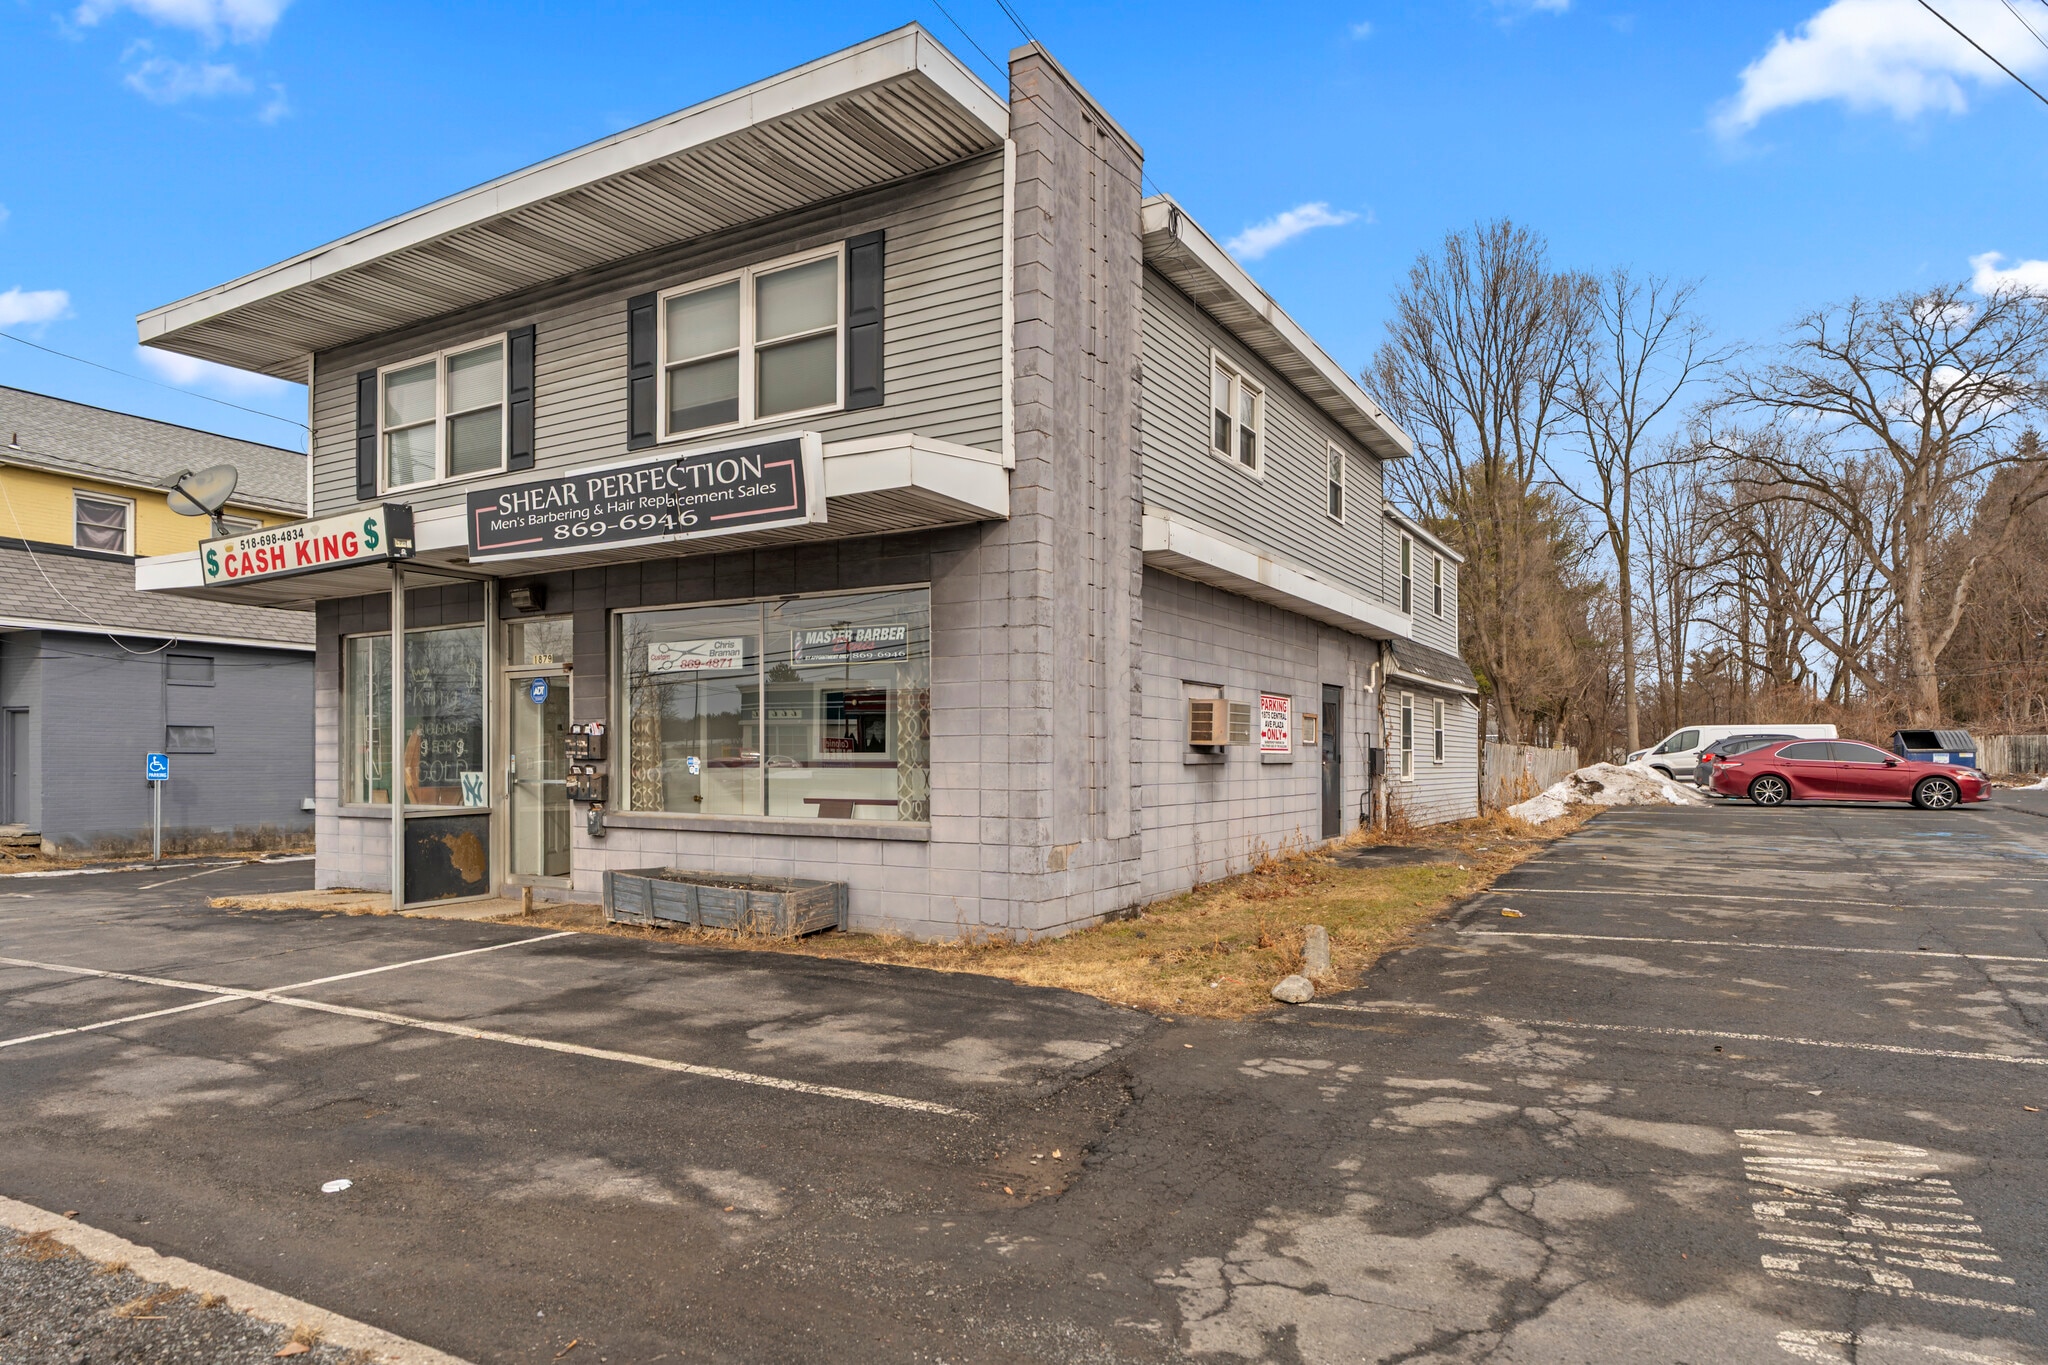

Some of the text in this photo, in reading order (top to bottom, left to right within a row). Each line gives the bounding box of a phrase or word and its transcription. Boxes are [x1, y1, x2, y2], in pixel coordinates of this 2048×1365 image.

[498, 454, 763, 515] SHEAR PERFECTION
[490, 481, 778, 532] Men's Barbering & Hair Replacement Sales
[553, 508, 699, 540] 869-6946
[240, 527, 305, 551] 518-698-4834
[224, 544, 286, 578] CASH
[295, 531, 359, 567] KING
[805, 626, 906, 645] MASTER BARBER
[714, 640, 735, 650] Chris
[534, 654, 552, 664] 1879
[709, 649, 740, 657] Braman
[852, 651, 906, 659] 869-6946
[680, 657, 733, 669] 869-4871
[533, 686, 545, 696] ADT
[1261, 699, 1286, 712] PARKING
[1271, 711, 1287, 720] CENTRAL
[1267, 728, 1282, 740] ONLY
